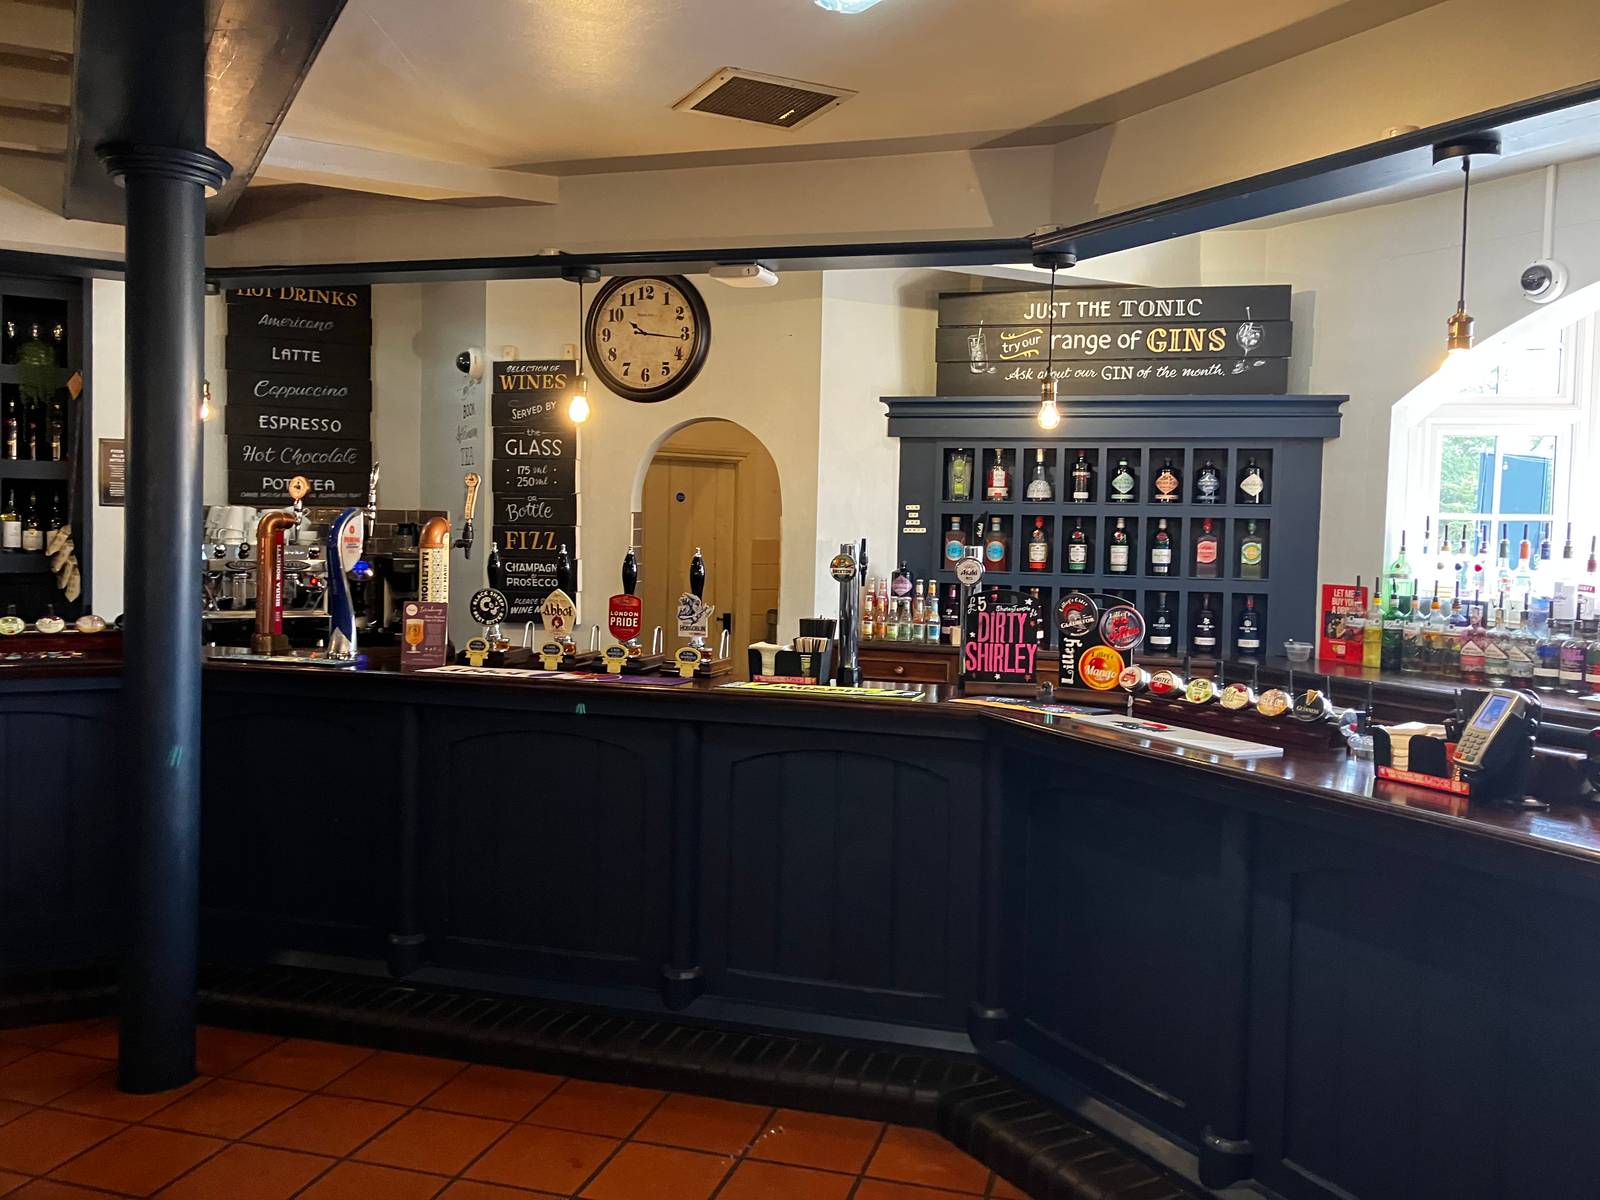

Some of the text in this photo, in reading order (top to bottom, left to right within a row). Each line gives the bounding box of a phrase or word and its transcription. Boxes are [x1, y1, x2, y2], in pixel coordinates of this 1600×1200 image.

[280, 286, 358, 307] DRINKS
[620, 293, 635, 306] 11
[638, 286, 654, 300] 12
[663, 292, 670, 305] 1
[608, 308, 624, 322] 10
[676, 306, 684, 320] 2
[1024, 298, 1203, 320] JUST THE TONIC
[258, 313, 335, 331] Americano
[602, 328, 611, 342] 9
[681, 327, 690, 340] 3
[1002, 327, 1227, 355] try our range of GINS
[272, 347, 321, 363] LATTE
[608, 347, 617, 361] 8
[674, 346, 683, 360] 4
[549, 364, 560, 372] OF
[622, 362, 631, 376] 7
[641, 368, 650, 382] 6
[661, 362, 670, 376] 5
[1005, 367, 1033, 380] Ask
[1037, 367, 1071, 380] aout
[1074, 369, 1098, 378] our
[1101, 365, 1134, 380] GIN
[1136, 366, 1152, 379] of
[1156, 365, 1177, 378] the
[253, 380, 349, 399] Cappuccino
[499, 374, 568, 391] WINES
[511, 401, 557, 421] SERVED BY
[259, 415, 342, 433] ESPRESSO
[526, 428, 541, 437] the
[505, 439, 562, 456] GLASS
[242, 445, 358, 466] Hot Chocolate
[517, 465, 531, 475] 175
[517, 476, 534, 488] 250
[505, 502, 554, 522] Bottle
[505, 531, 558, 550] FIZZ
[505, 561, 558, 573] CHAMPAGN
[421, 551, 430, 602] MORETTI
[506, 577, 559, 587] PROSECCO
[510, 605, 534, 614] WINE
[542, 603, 574, 617] Abbot
[967, 596, 987, 614] £5
[610, 617, 639, 627] PRIDE
[978, 611, 1027, 644] DIRTY
[965, 641, 1038, 674] SHIRLEY
[1084, 664, 1116, 679] Mango
